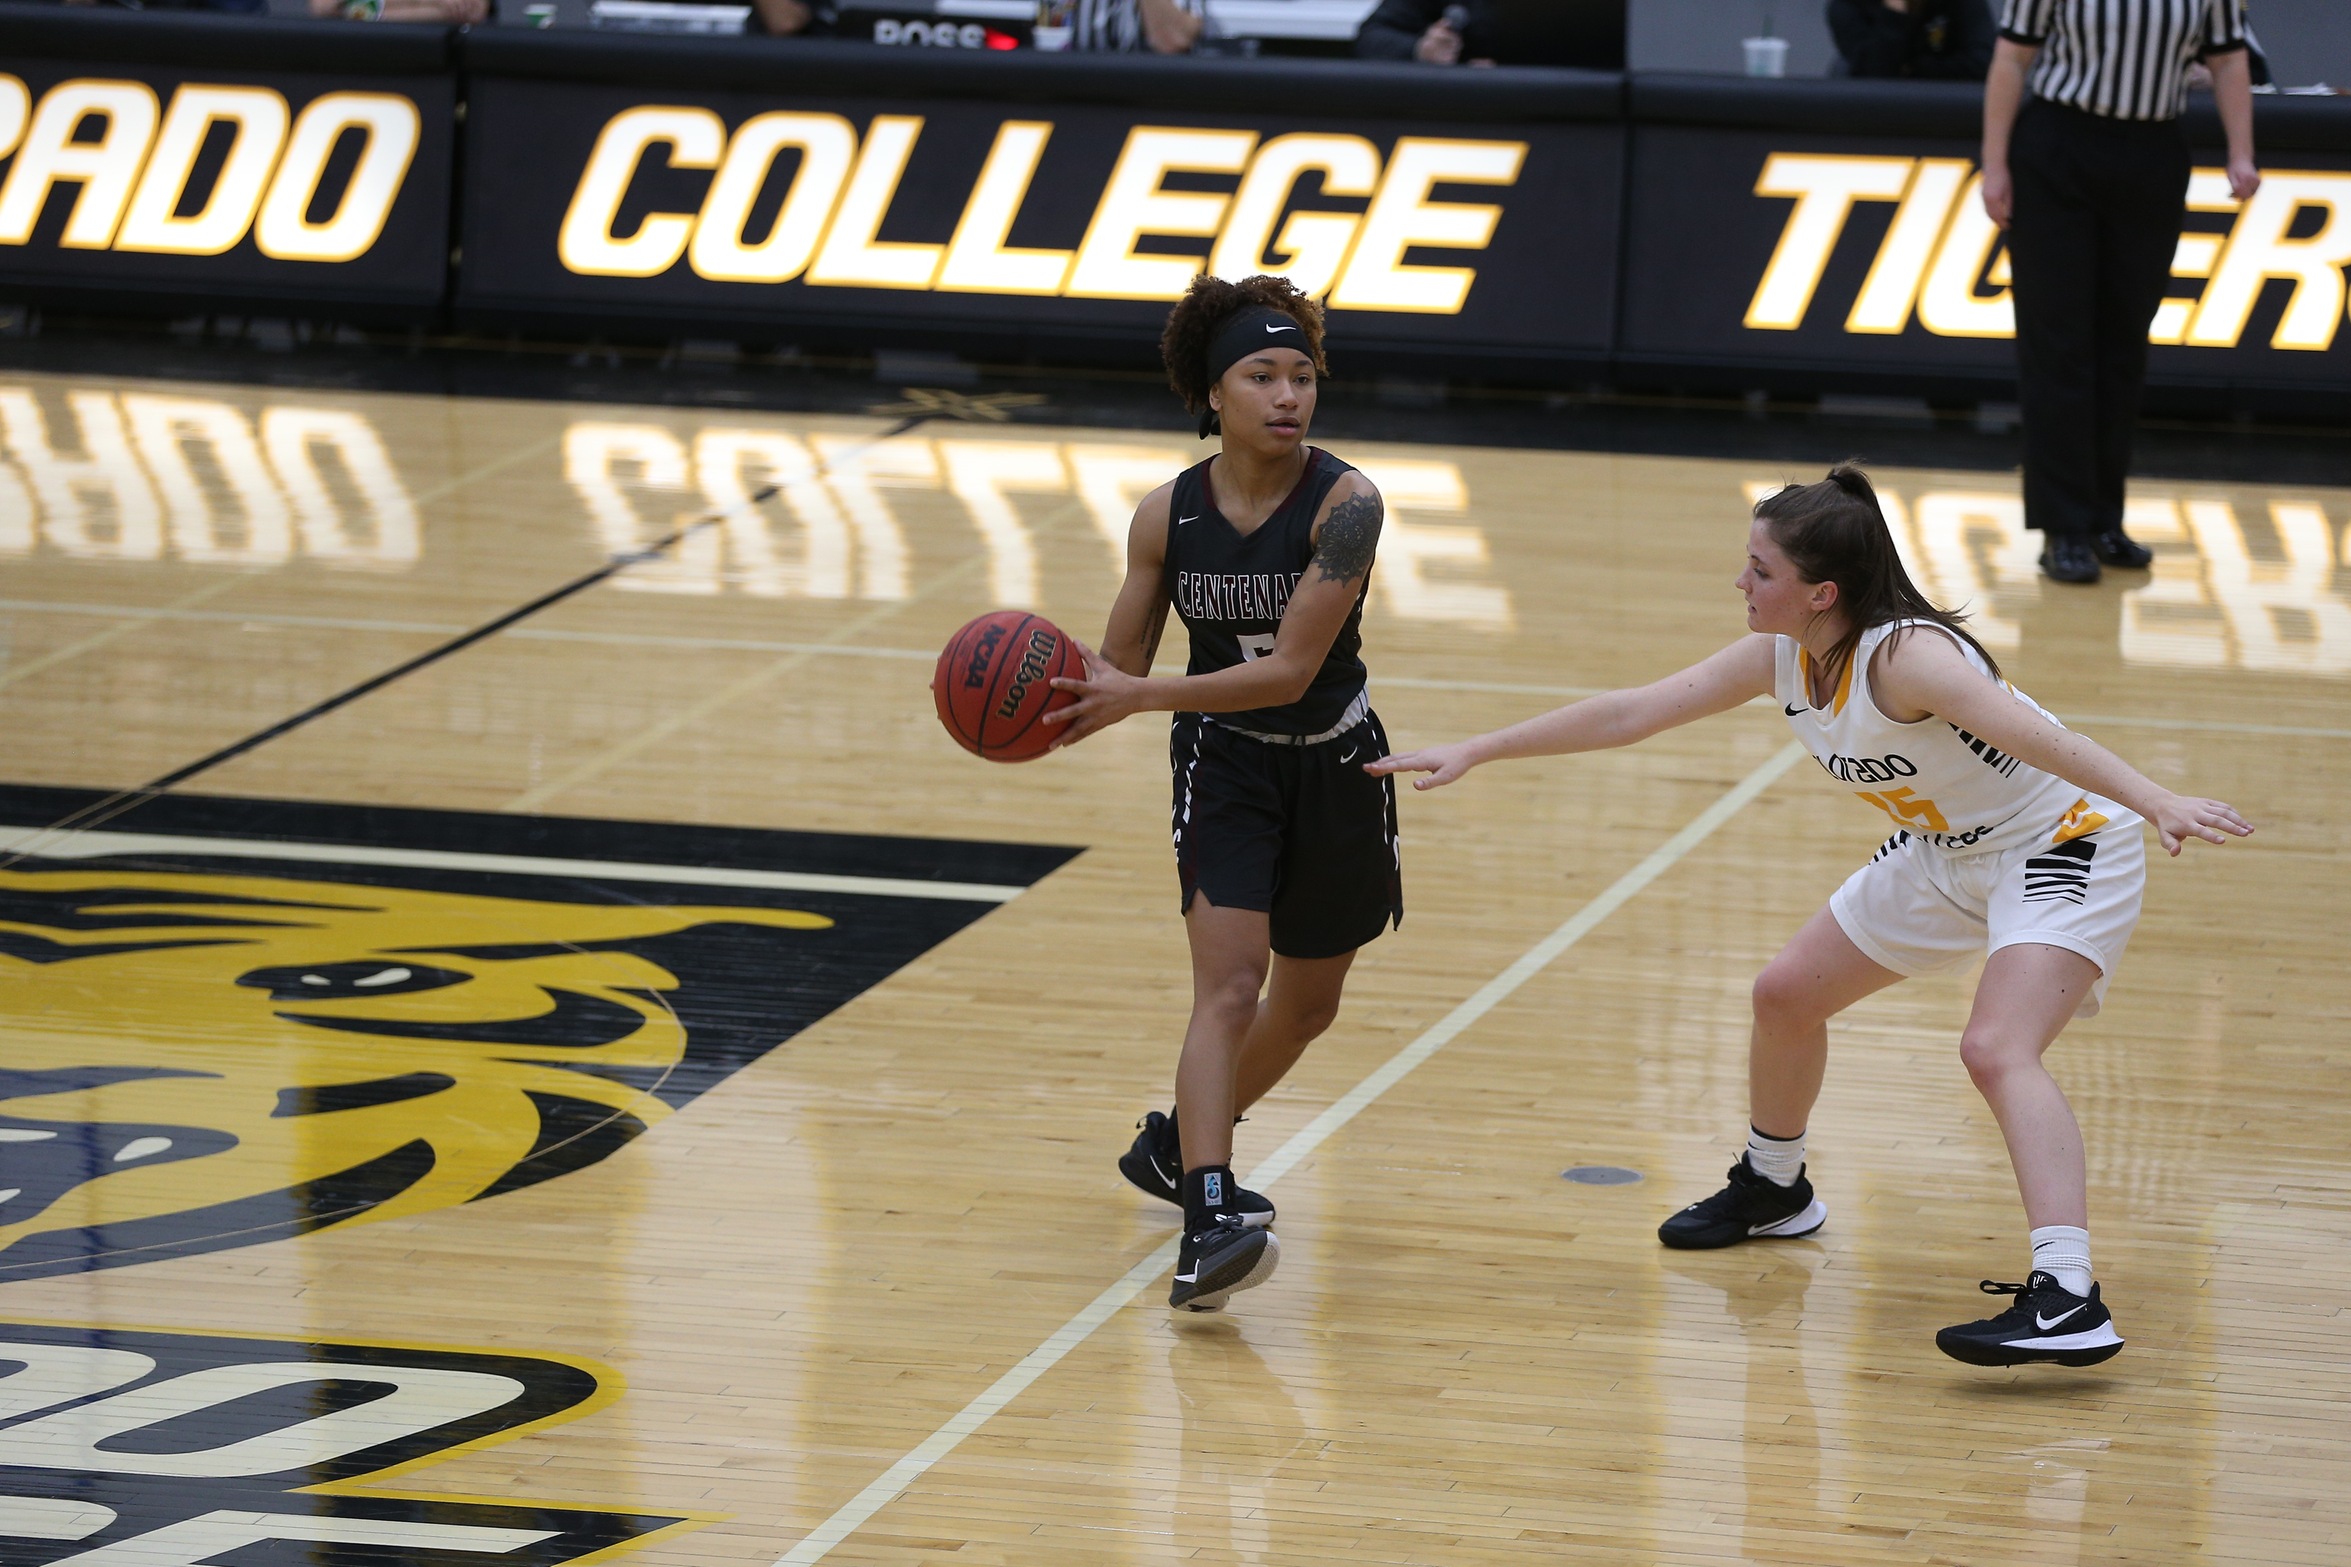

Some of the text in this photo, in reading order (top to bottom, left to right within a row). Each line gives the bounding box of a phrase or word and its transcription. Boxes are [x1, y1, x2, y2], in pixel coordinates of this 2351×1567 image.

[0, 72, 2351, 351] ADO COLLEGE TIGR
[1178, 571, 1304, 620] CENTENA
[965, 624, 1007, 688] NCAA
[996, 629, 1057, 719] Wilson
